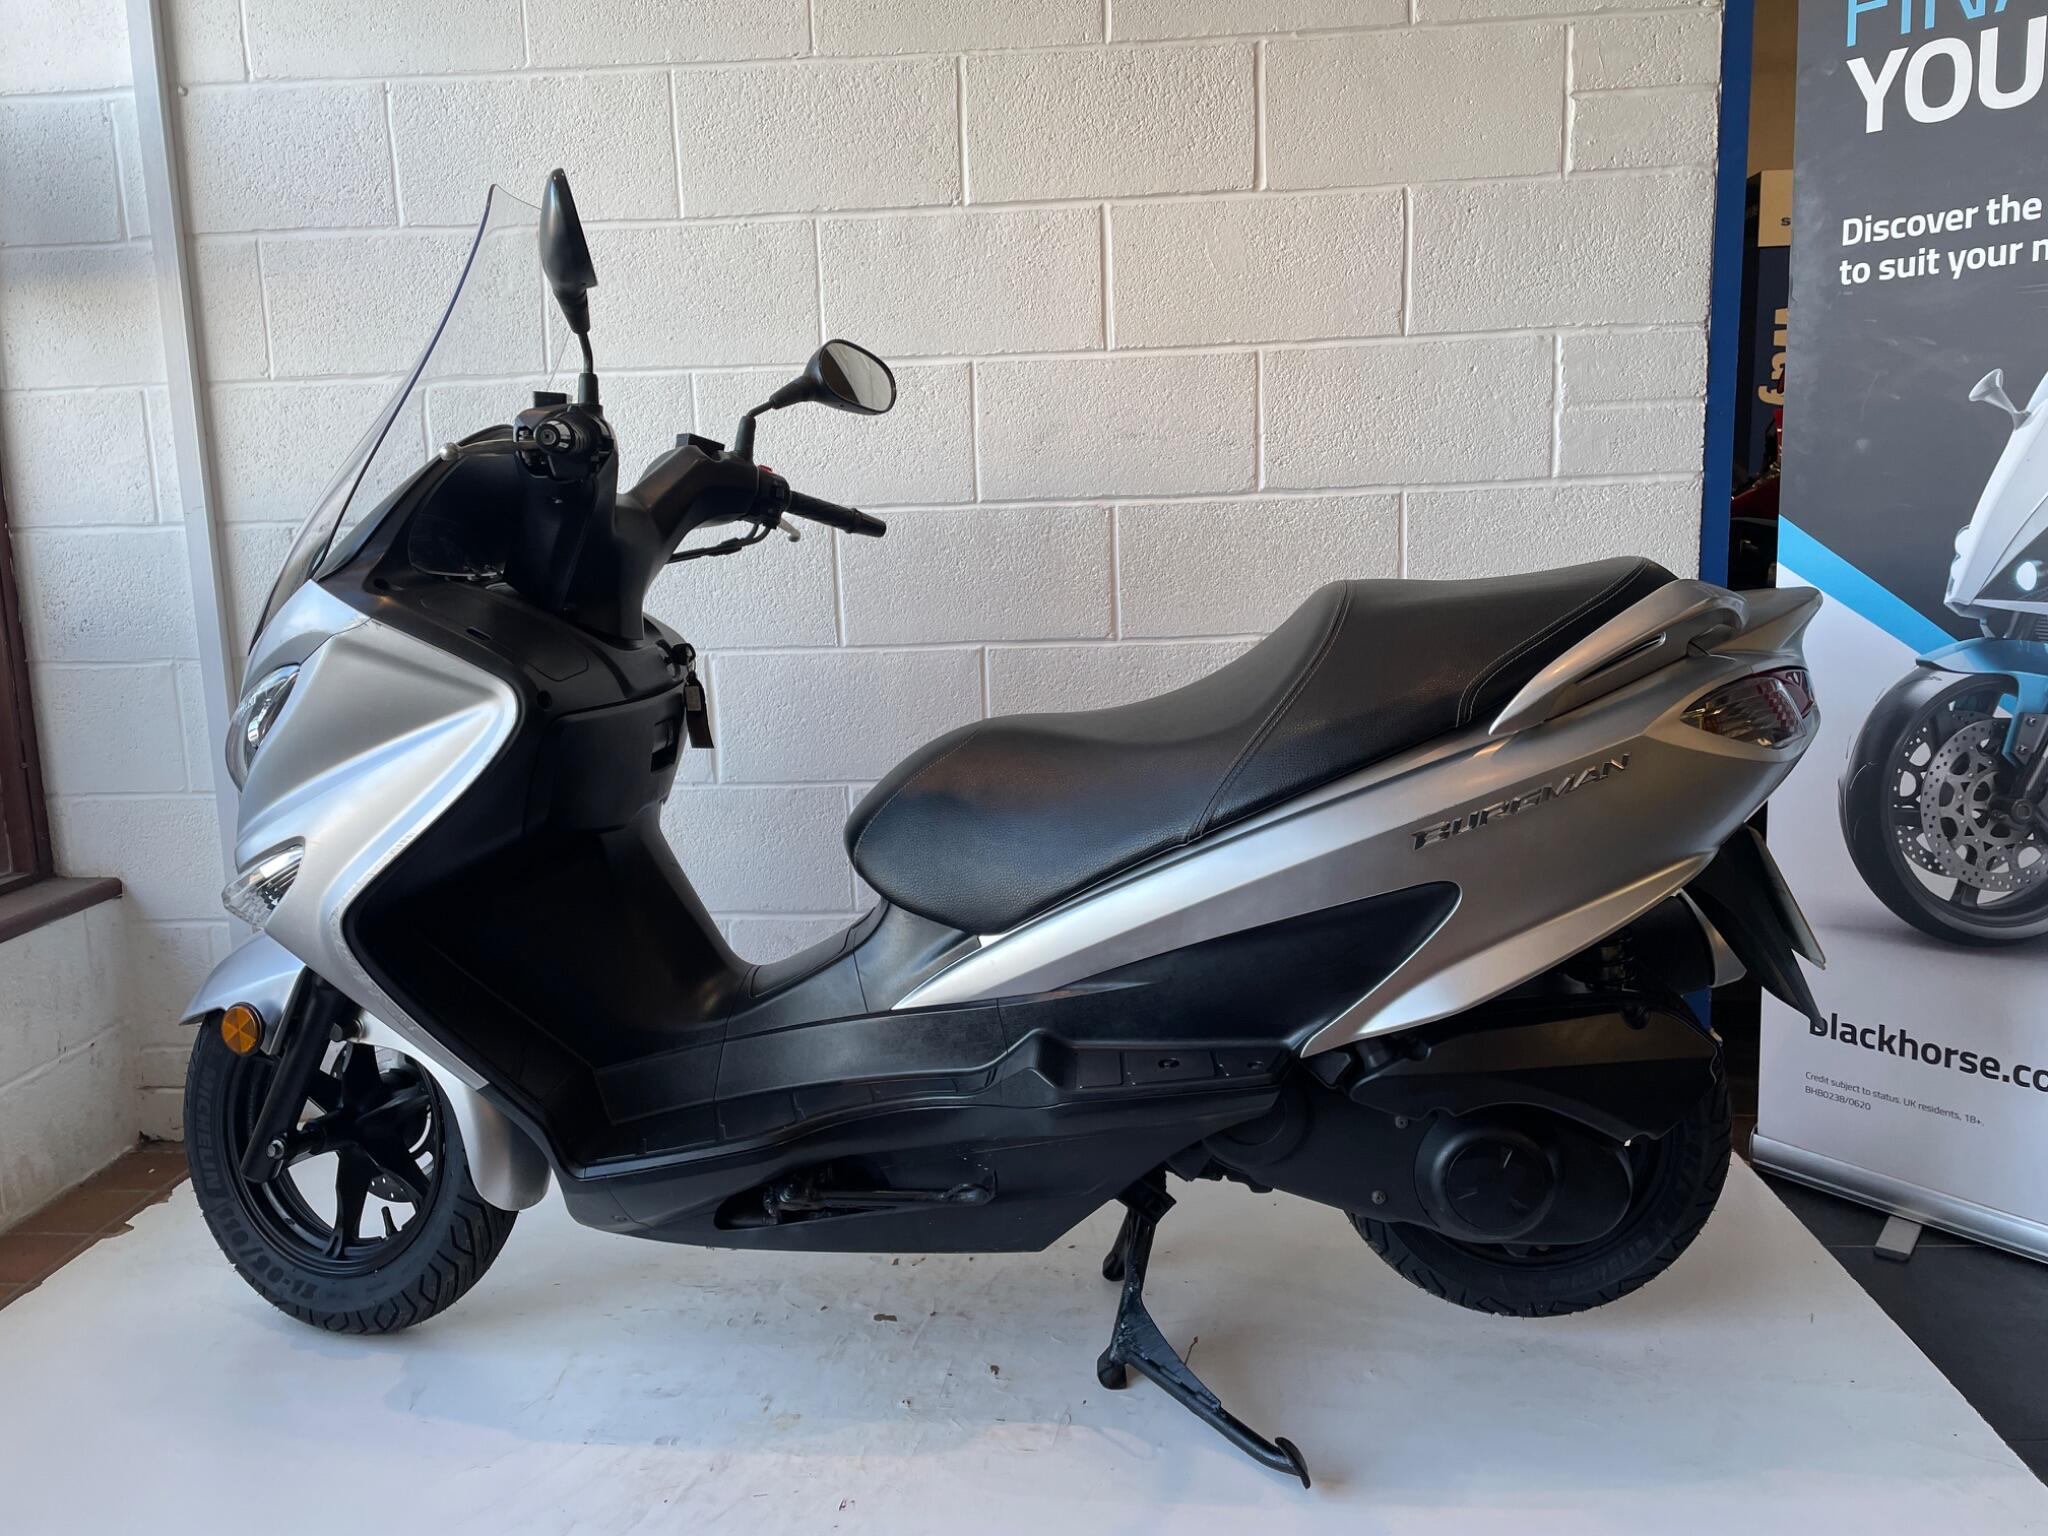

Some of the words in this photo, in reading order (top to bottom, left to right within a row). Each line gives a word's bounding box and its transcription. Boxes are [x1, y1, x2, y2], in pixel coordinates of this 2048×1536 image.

[1846, 16, 2048, 133] YOU
[1841, 204, 1979, 246] Discover
[1986, 194, 2042, 226] the
[1839, 259, 1870, 285] to
[1878, 247, 1940, 281] suit
[1947, 241, 2023, 279] your
[1410, 753, 1631, 850] BURGMAN
[1805, 1071, 1829, 1084] Credit
[1831, 1080, 1860, 1093] subject
[1862, 1086, 1871, 1096] to
[1903, 1098, 1916, 1109] UK
[196, 1066, 219, 1190] MICHELIN
